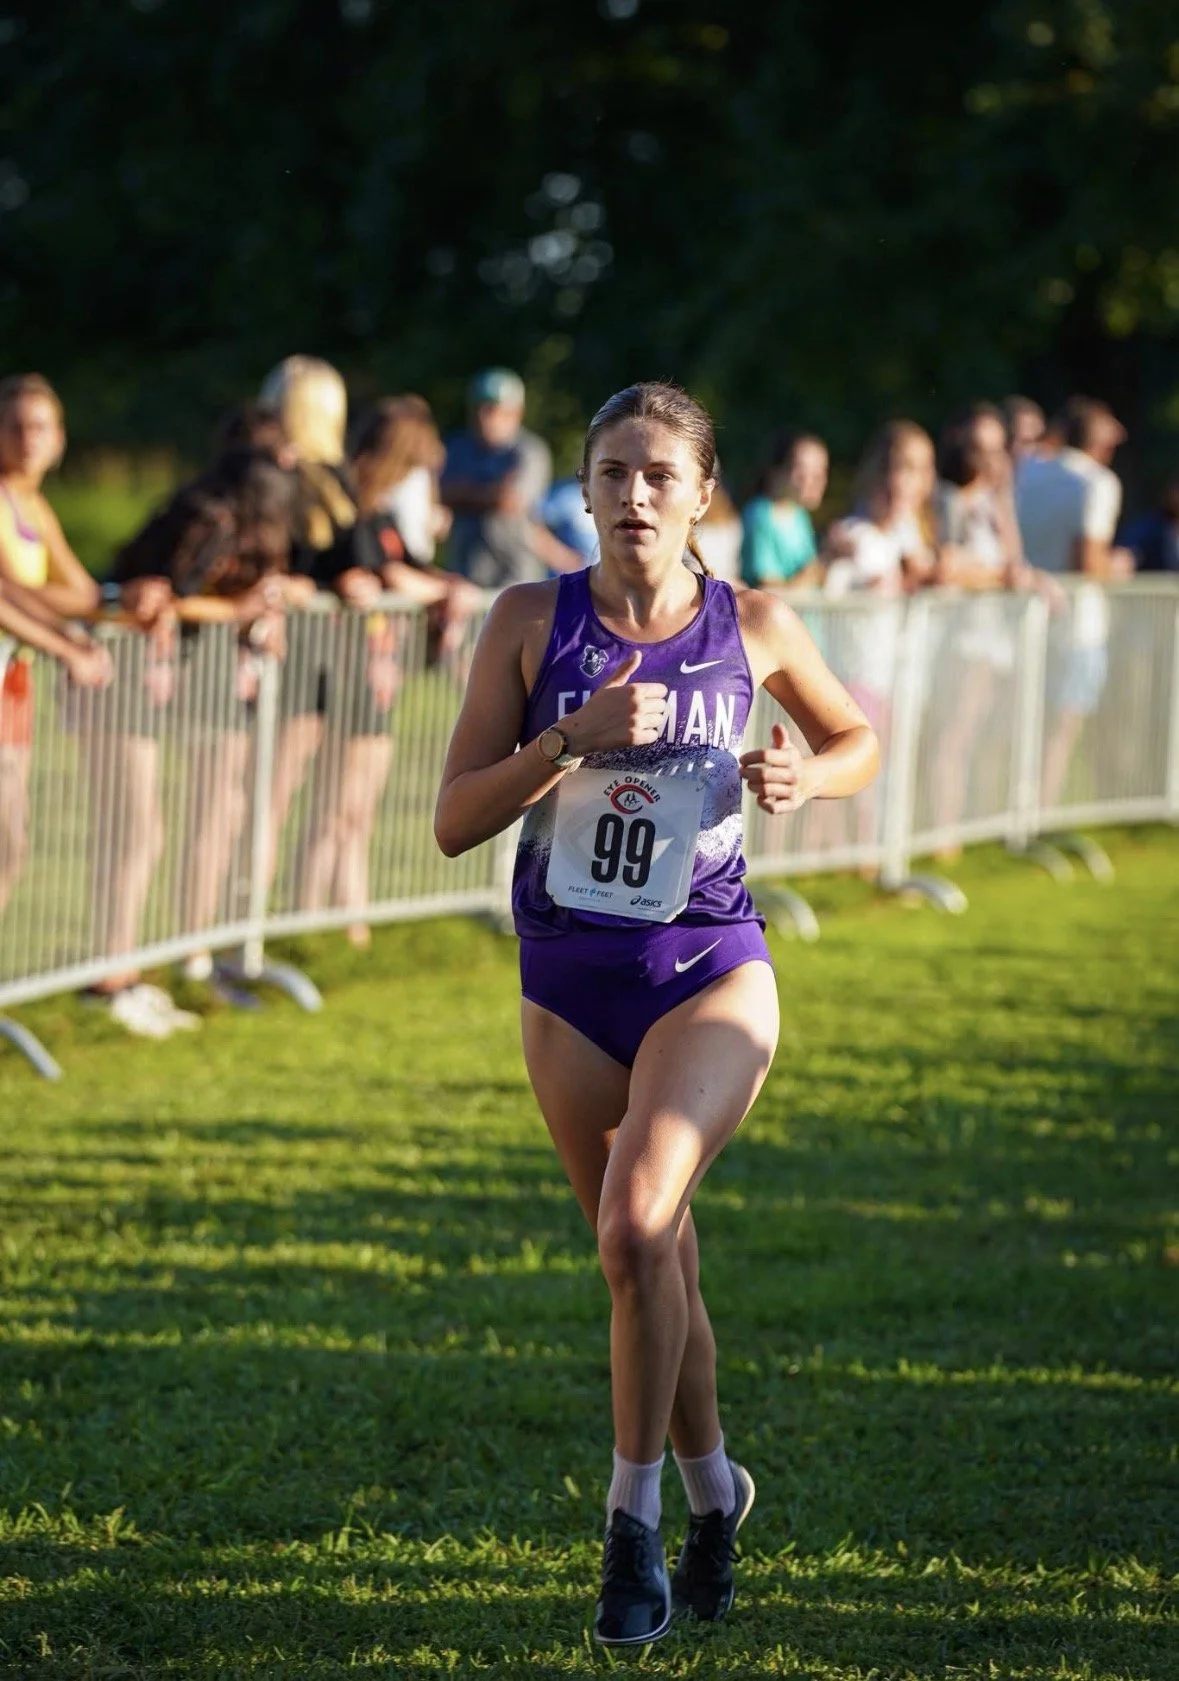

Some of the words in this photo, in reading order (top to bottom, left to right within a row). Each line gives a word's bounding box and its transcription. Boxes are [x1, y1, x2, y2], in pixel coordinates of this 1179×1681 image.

[603, 779, 620, 796] EYE
[624, 776, 661, 802] OPENER
[591, 813, 656, 888] 99
[568, 886, 588, 894] FLEET
[596, 890, 613, 898] FEET
